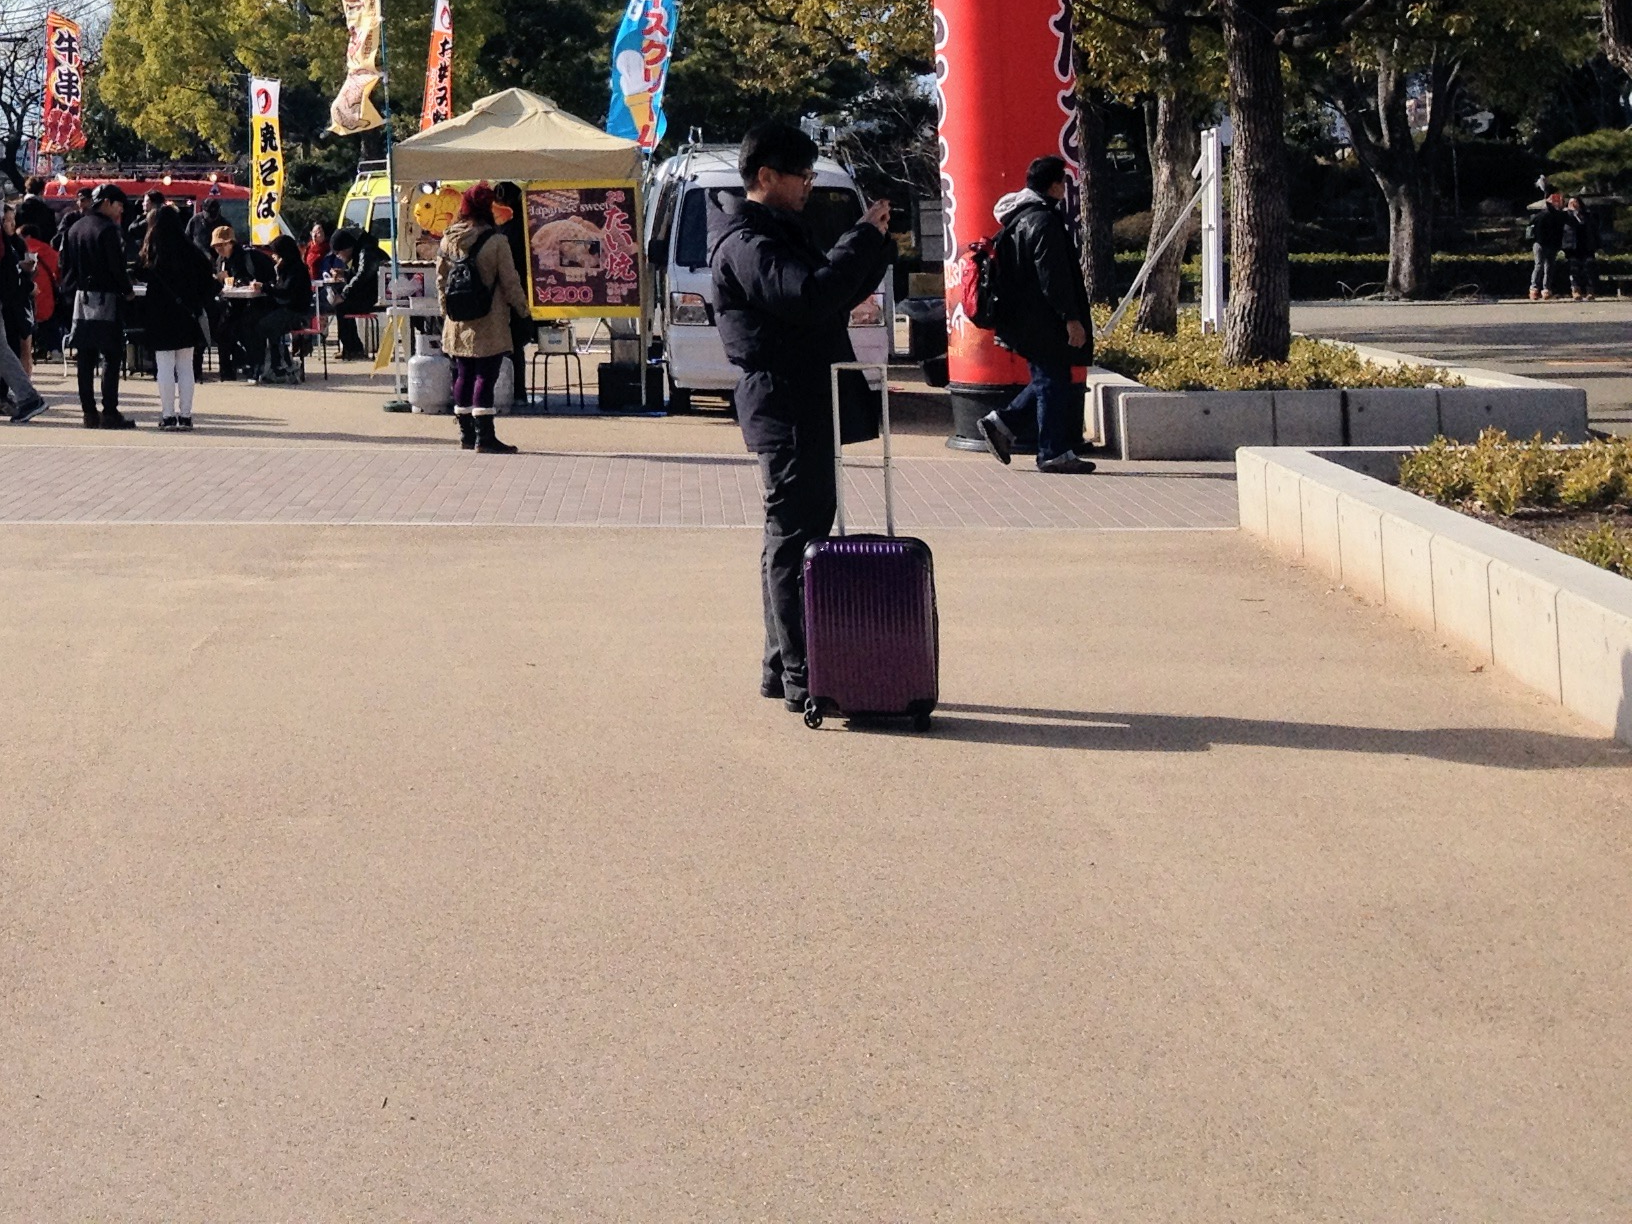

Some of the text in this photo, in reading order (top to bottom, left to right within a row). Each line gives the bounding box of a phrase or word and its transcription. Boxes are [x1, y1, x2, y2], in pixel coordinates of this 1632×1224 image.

[55, 28, 80, 103] 牛串
[605, 205, 637, 280] たい焼
[536, 286, 593, 304] ¥200
